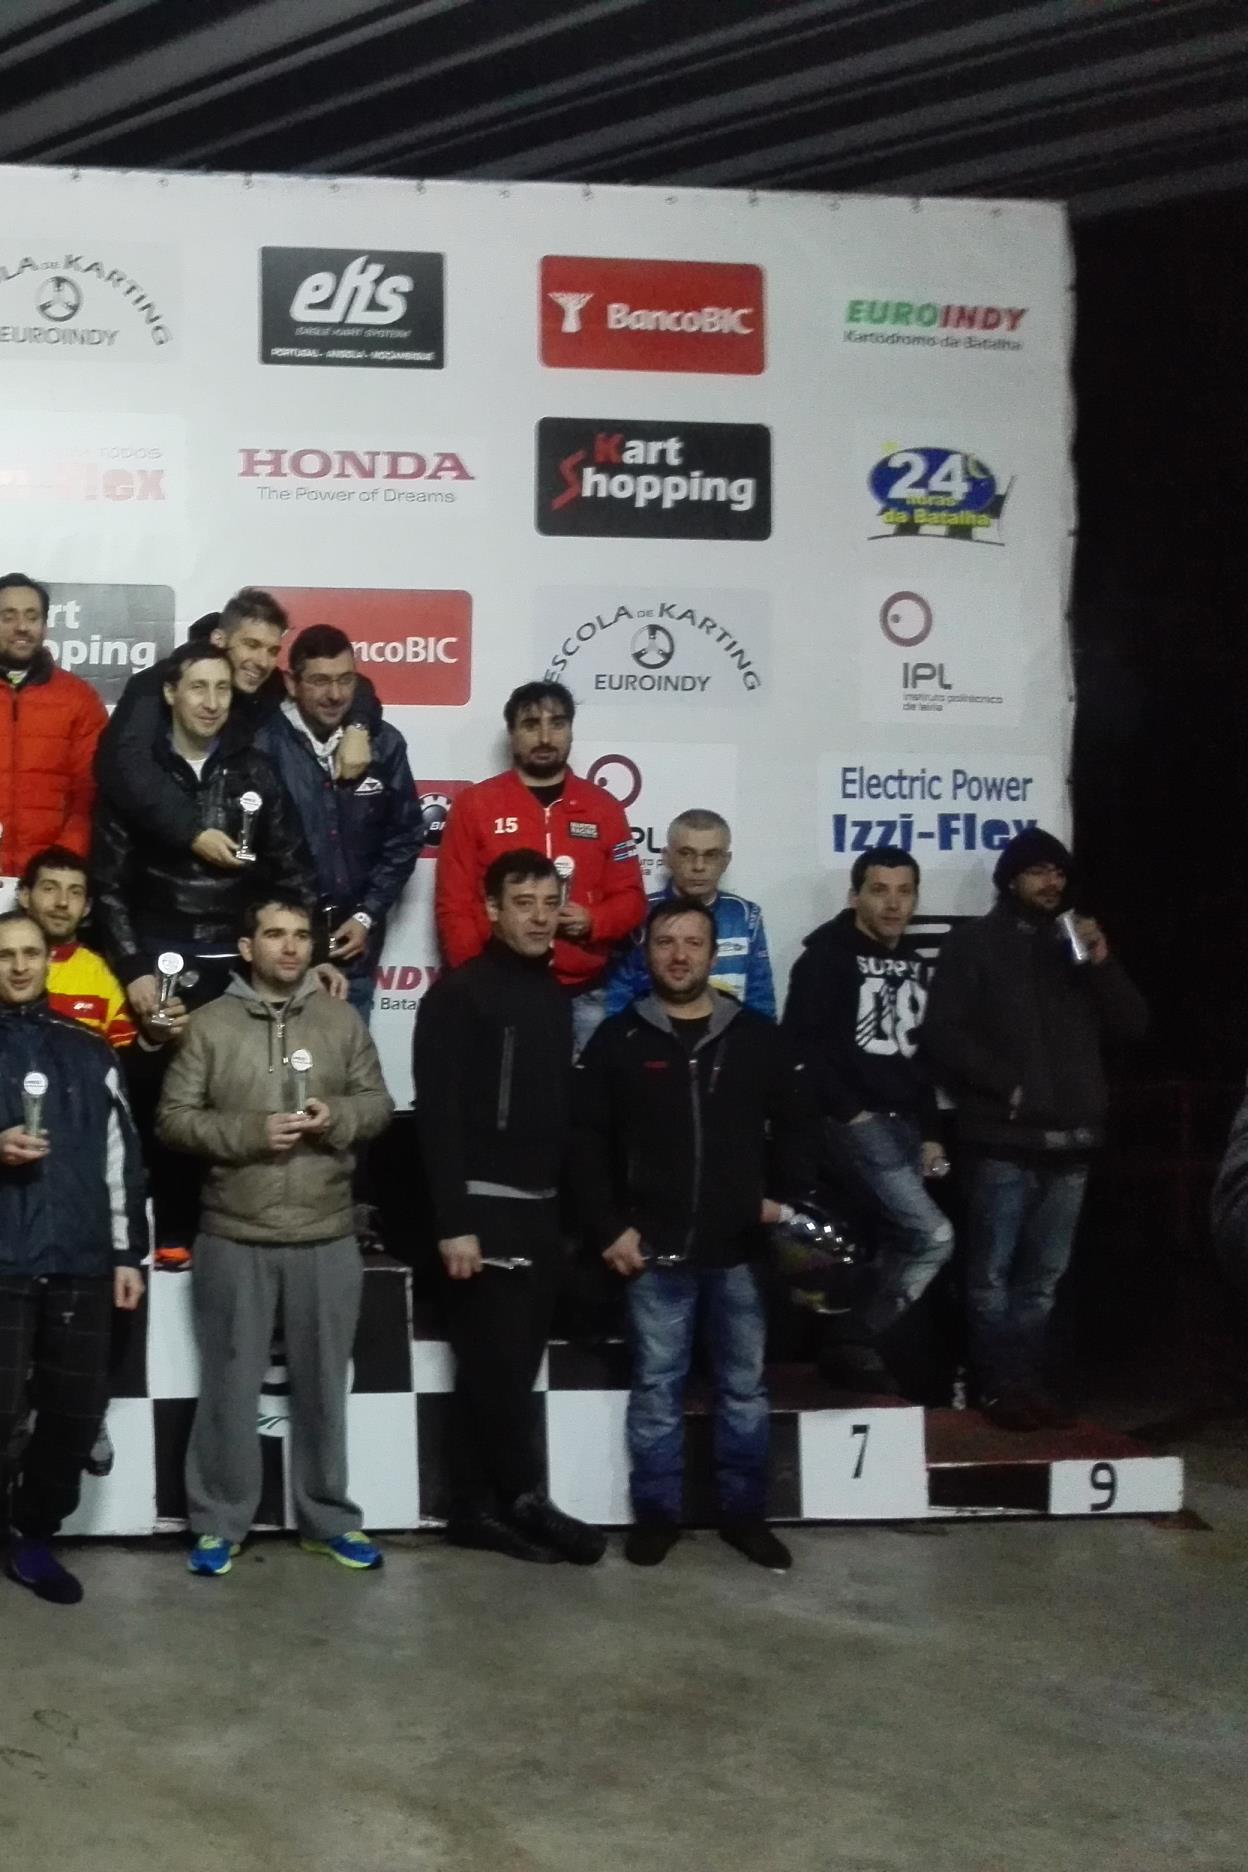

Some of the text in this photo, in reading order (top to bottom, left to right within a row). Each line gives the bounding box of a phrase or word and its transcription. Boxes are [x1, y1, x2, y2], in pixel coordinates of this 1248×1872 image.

[64, 254, 172, 345] KARTING
[846, 300, 1027, 331] EUROINDY
[607, 303, 753, 334] BancoBIC
[237, 448, 475, 480] HONDA
[594, 433, 684, 466] Kart
[552, 449, 757, 512] Shopping
[887, 453, 968, 501] 24
[257, 486, 456, 503] The Power of Dreams
[351, 637, 459, 664] ncoBIC
[543, 606, 634, 685] ESCOLA
[658, 602, 761, 691] KARTING
[595, 674, 711, 692] EUROINDY
[903, 662, 953, 690] IPL
[841, 766, 1033, 801] Electric Power
[494, 817, 519, 834] 15
[850, 1424, 871, 1479] 7
[1089, 1462, 1118, 1511] 9
